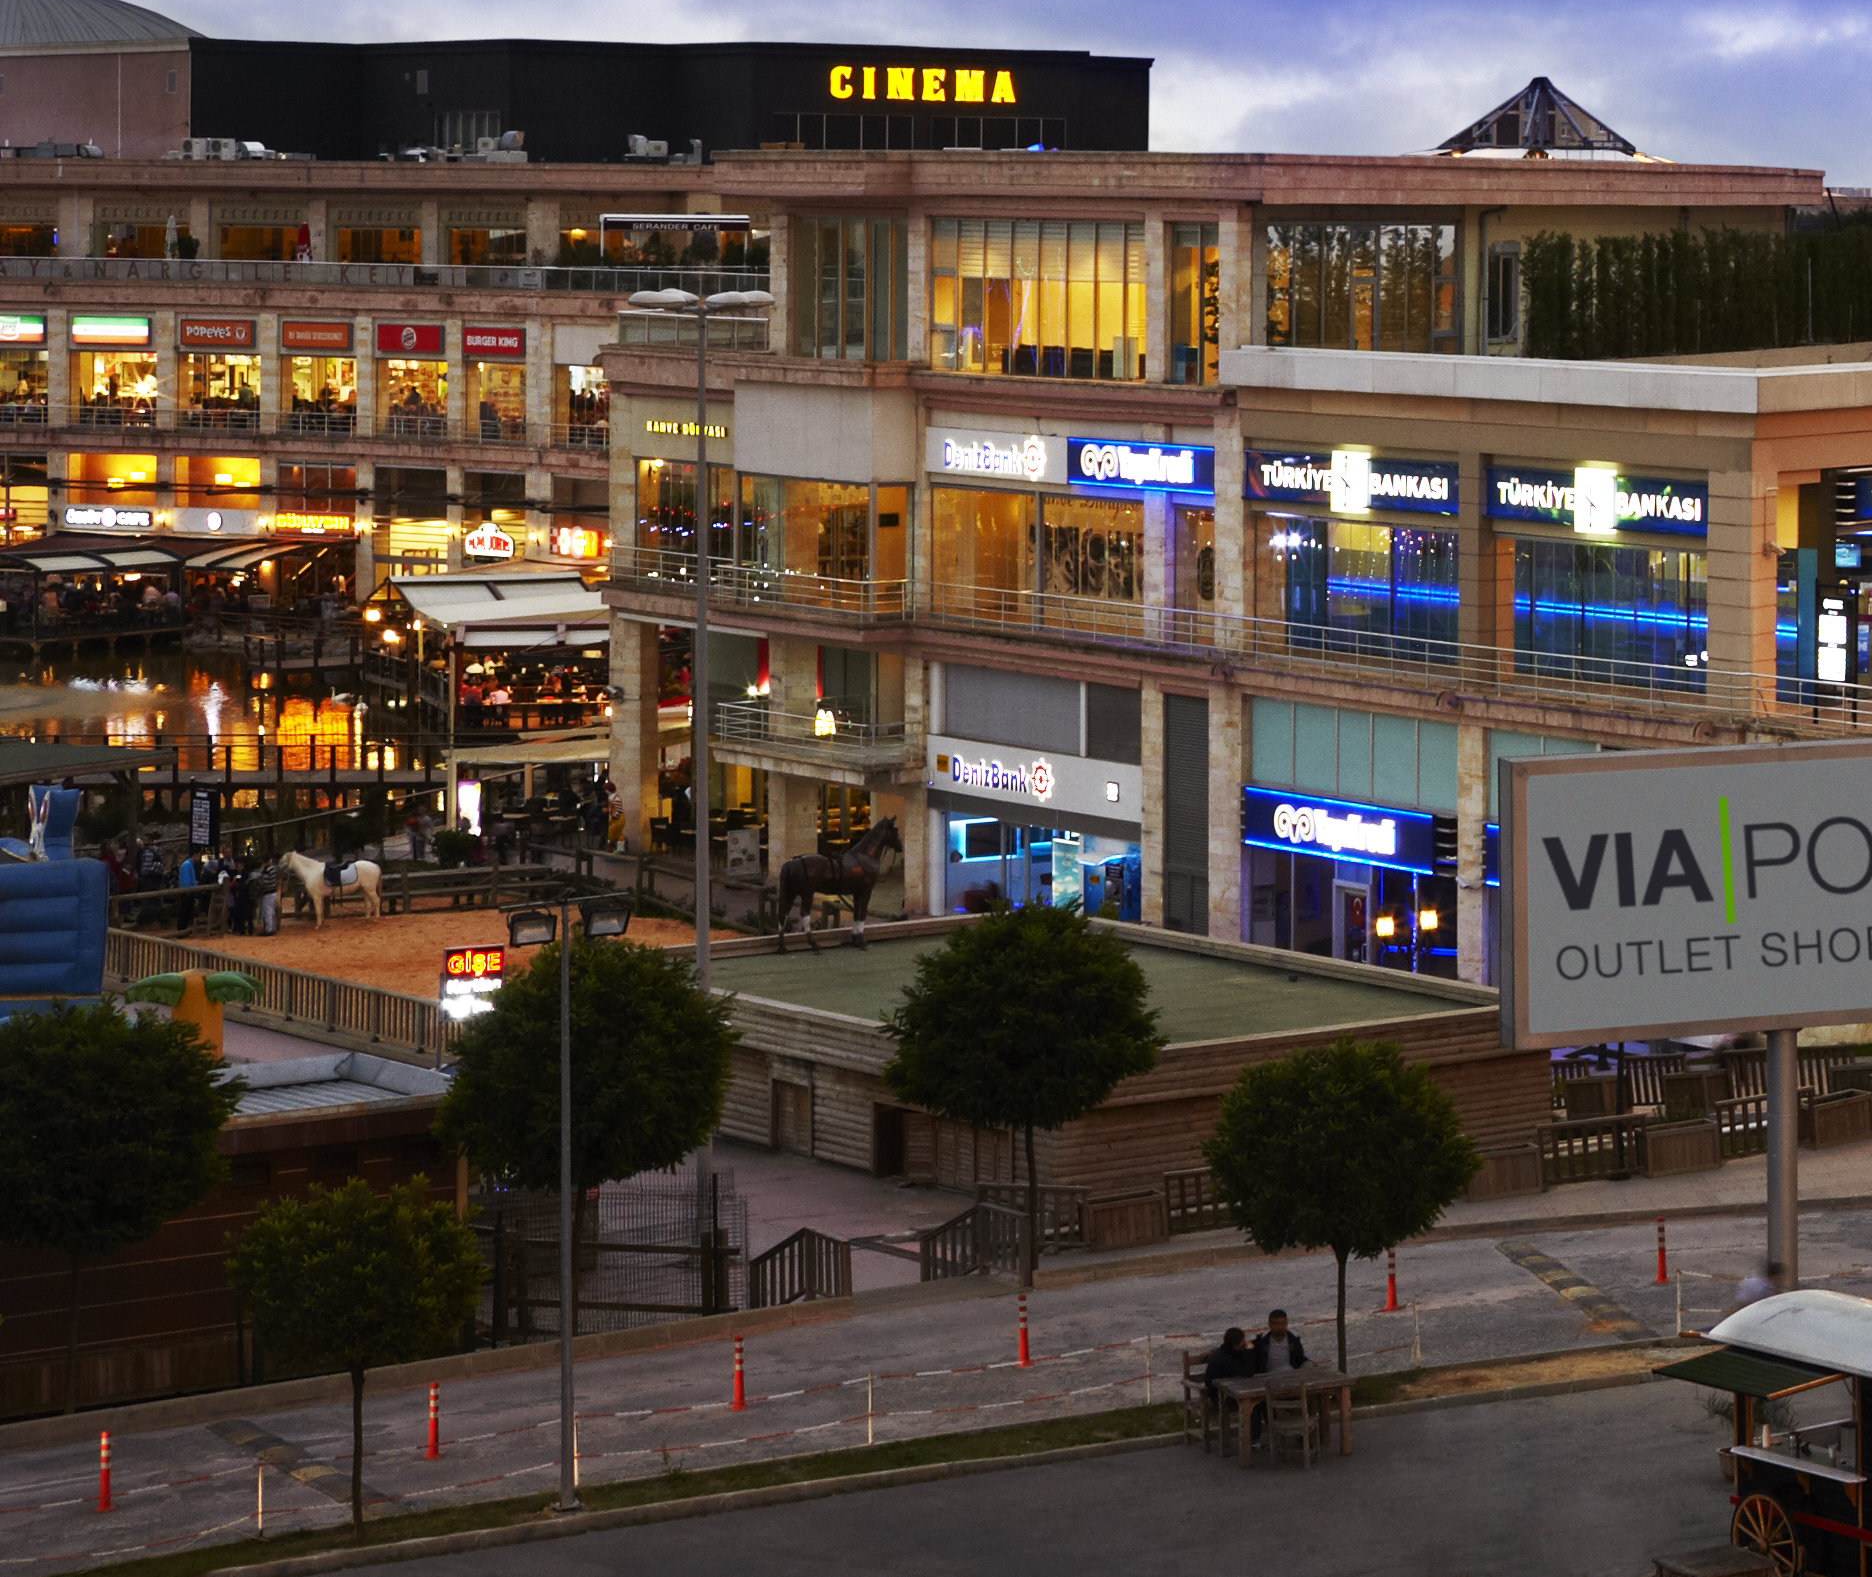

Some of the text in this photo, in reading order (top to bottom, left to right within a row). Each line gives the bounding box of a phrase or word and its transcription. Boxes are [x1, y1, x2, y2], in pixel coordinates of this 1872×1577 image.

[829, 65, 1017, 104] CINEMA
[693, 223, 721, 231] CAFE
[466, 335, 518, 348] BURGER KING
[1261, 460, 1449, 500] TÜRKİYE BANKASI
[1497, 478, 1702, 522] TÜRKİYE BANKASI
[952, 755, 1029, 793] DenizBank
[1542, 828, 1713, 911] VIA
[1556, 934, 1740, 981] OUTLET
